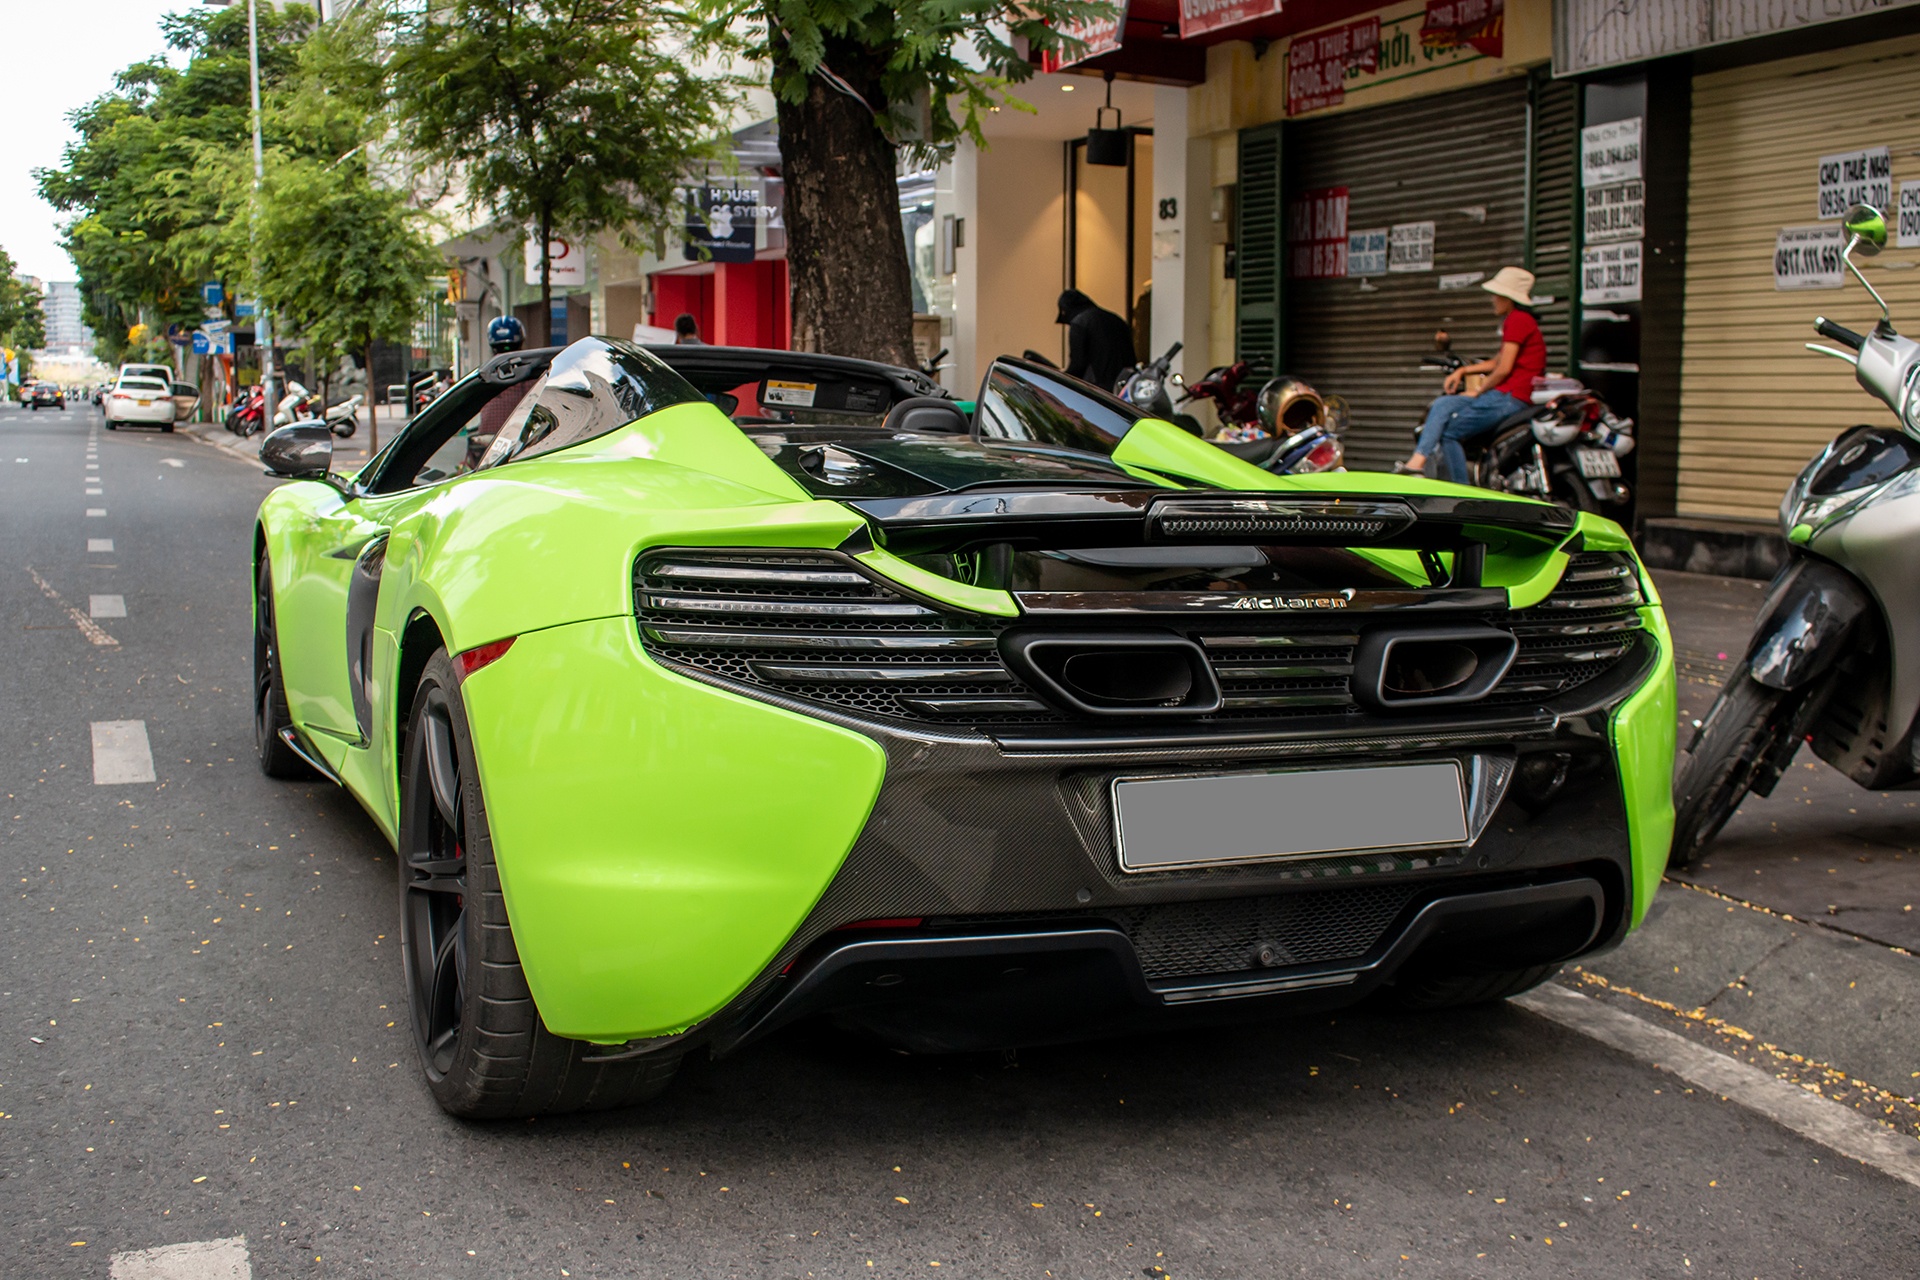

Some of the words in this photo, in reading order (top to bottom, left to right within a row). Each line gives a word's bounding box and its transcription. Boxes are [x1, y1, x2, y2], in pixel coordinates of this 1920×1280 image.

[1290, 40, 1315, 67] CHO
[1820, 160, 1840, 185] CHO
[1843, 153, 1867, 182] THUÊ
[710, 189, 760, 203] HOUSE
[1159, 198, 1177, 220] 83
[1775, 244, 1842, 276] 0917.111.661
[1232, 596, 1348, 611] McLaren
